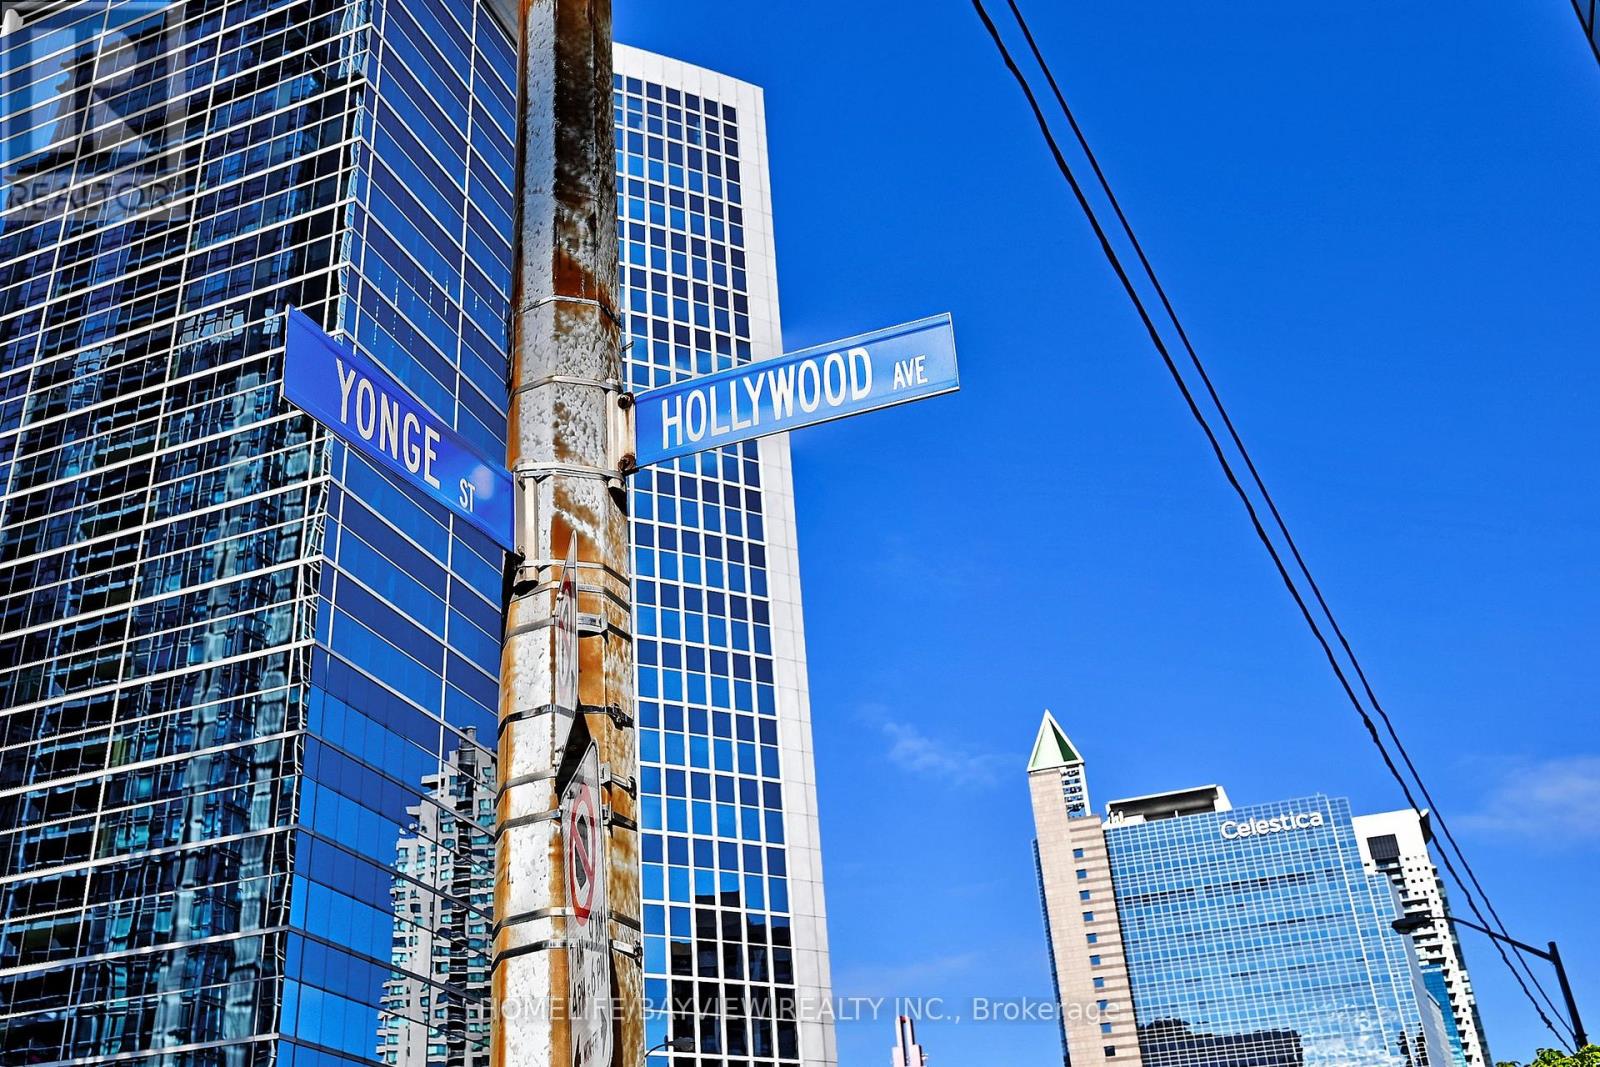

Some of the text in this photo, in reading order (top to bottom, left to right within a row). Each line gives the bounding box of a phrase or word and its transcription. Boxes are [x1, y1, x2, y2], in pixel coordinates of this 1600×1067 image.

[335, 357, 476, 513] YONGE ST
[661, 346, 929, 450] HOLLYWOOD AVE
[1220, 810, 1325, 841] Celestica
